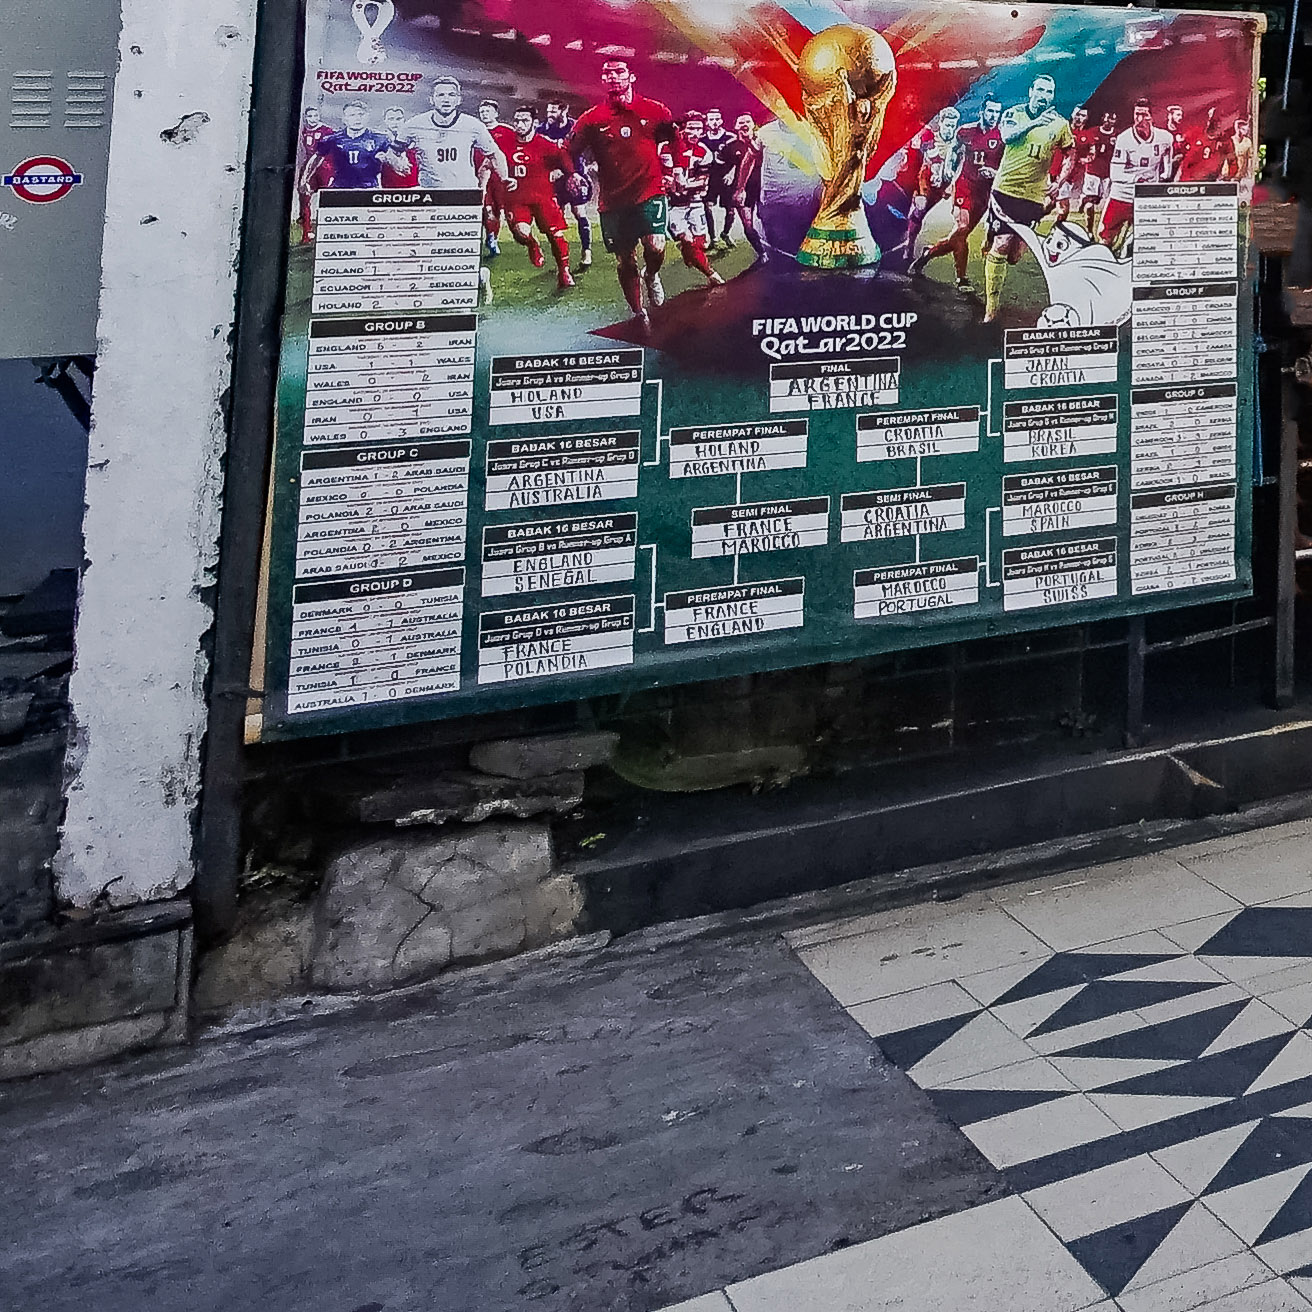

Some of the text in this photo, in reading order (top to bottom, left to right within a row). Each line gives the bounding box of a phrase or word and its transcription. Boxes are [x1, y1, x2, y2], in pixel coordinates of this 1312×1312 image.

[316, 71, 423, 83] FIFA WORLD CUP
[372, 194, 433, 203] GROUP A
[365, 321, 413, 332] GROUP
[753, 313, 918, 335] FIFA WORLD CUP
[579, 355, 620, 366] BESAR
[820, 364, 851, 373] FINAL
[1025, 357, 1069, 371] JAPAN
[1030, 370, 1086, 385] CROATIA
[510, 387, 583, 404] HOLAND
[1165, 390, 1197, 399] GROUP
[531, 405, 565, 420] USA
[876, 412, 960, 427] PEREMPAT FINAL
[693, 425, 787, 440] PEREMPAT FINAL
[884, 425, 944, 442] CROATIA
[1028, 428, 1077, 445] BRASIL
[575, 437, 617, 449] BESAR
[695, 441, 760, 458] HOLAND
[886, 442, 940, 457] BRASIL
[1031, 444, 1077, 458] KOREA
[357, 449, 419, 462] GROUP C
[683, 457, 767, 476] ARGENTINA
[508, 469, 605, 491] ARGENTINA
[509, 485, 603, 508] AUSTRALIA
[731, 506, 792, 519] SEMI FINAL
[863, 503, 930, 524] CROATIA
[1022, 501, 1082, 518] MAROCCO
[508, 527, 552, 539] BABAK
[572, 520, 614, 533] BESAR
[723, 518, 793, 538] FRANCE
[863, 516, 948, 539] ARGENTINA
[1030, 517, 1070, 532] SPAIN
[721, 533, 800, 556] MAROCCO
[513, 552, 593, 573] ENGLAND
[515, 569, 598, 592] SENEGAL
[873, 563, 958, 582] PEREMPAT FINAL
[1035, 571, 1105, 589] PORTUGAL
[350, 580, 400, 593] GROUP
[687, 585, 782, 604] PEREMPAT FINAL
[881, 578, 947, 598] MAROCCO
[693, 602, 758, 622] FRANCE
[878, 594, 953, 616] PORTUGAL
[504, 612, 549, 625] BABAK
[569, 603, 611, 616] BESAR
[686, 618, 765, 640] ENGLAND
[502, 639, 572, 662] FRANCE
[504, 655, 588, 678] POLANDIA
